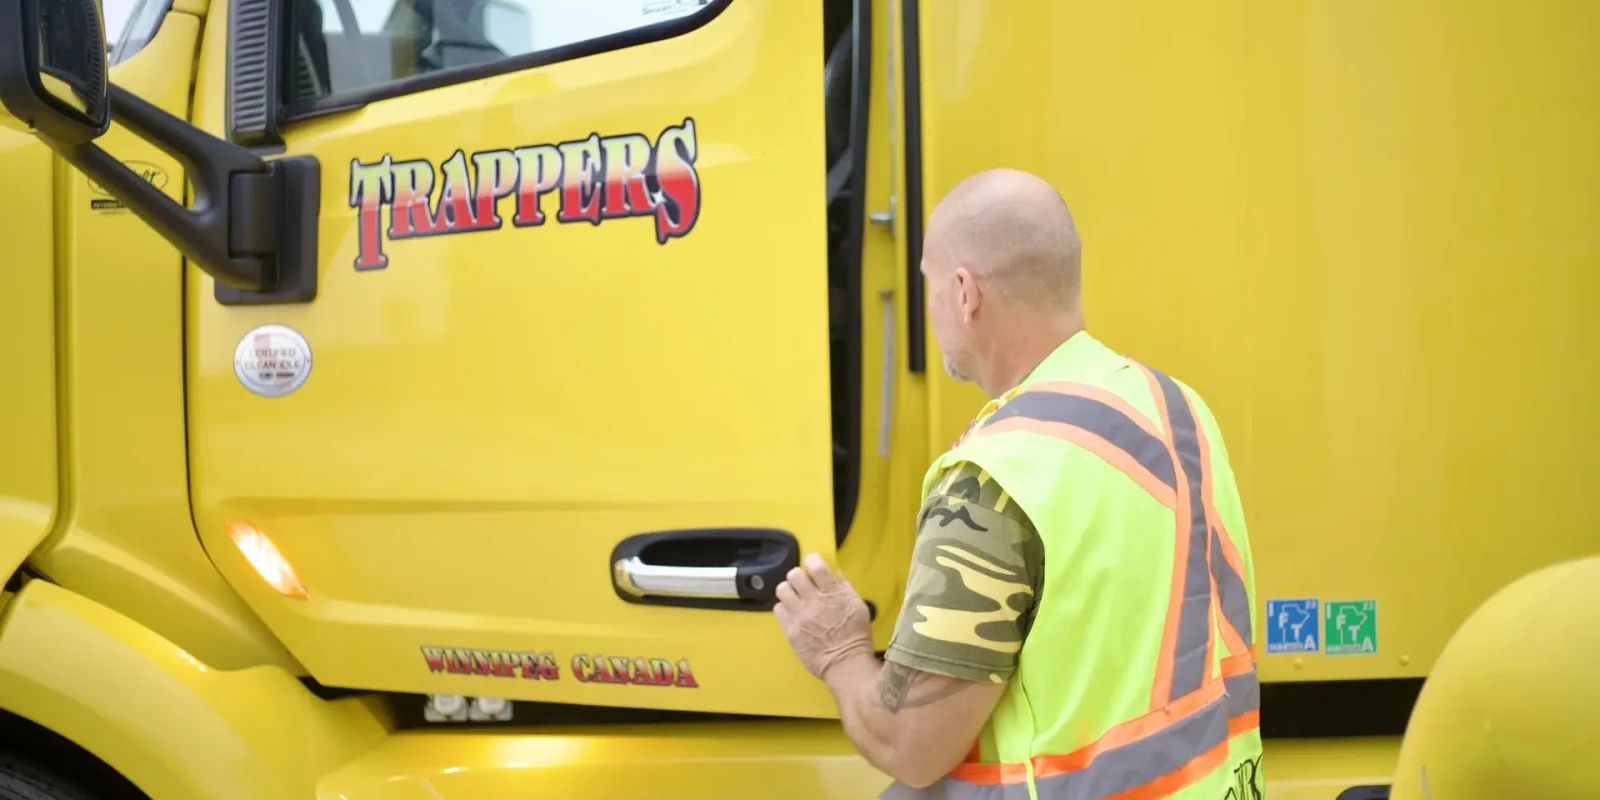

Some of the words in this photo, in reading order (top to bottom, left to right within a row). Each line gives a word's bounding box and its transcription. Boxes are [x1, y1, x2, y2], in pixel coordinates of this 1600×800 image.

[349, 117, 702, 272] TRAPPERS
[244, 361, 276, 371] CLEAN
[279, 361, 301, 370] IDLE
[249, 348, 296, 358] CERTIFIED
[420, 645, 560, 681] WINNIPEG
[571, 653, 699, 688] CANADA
